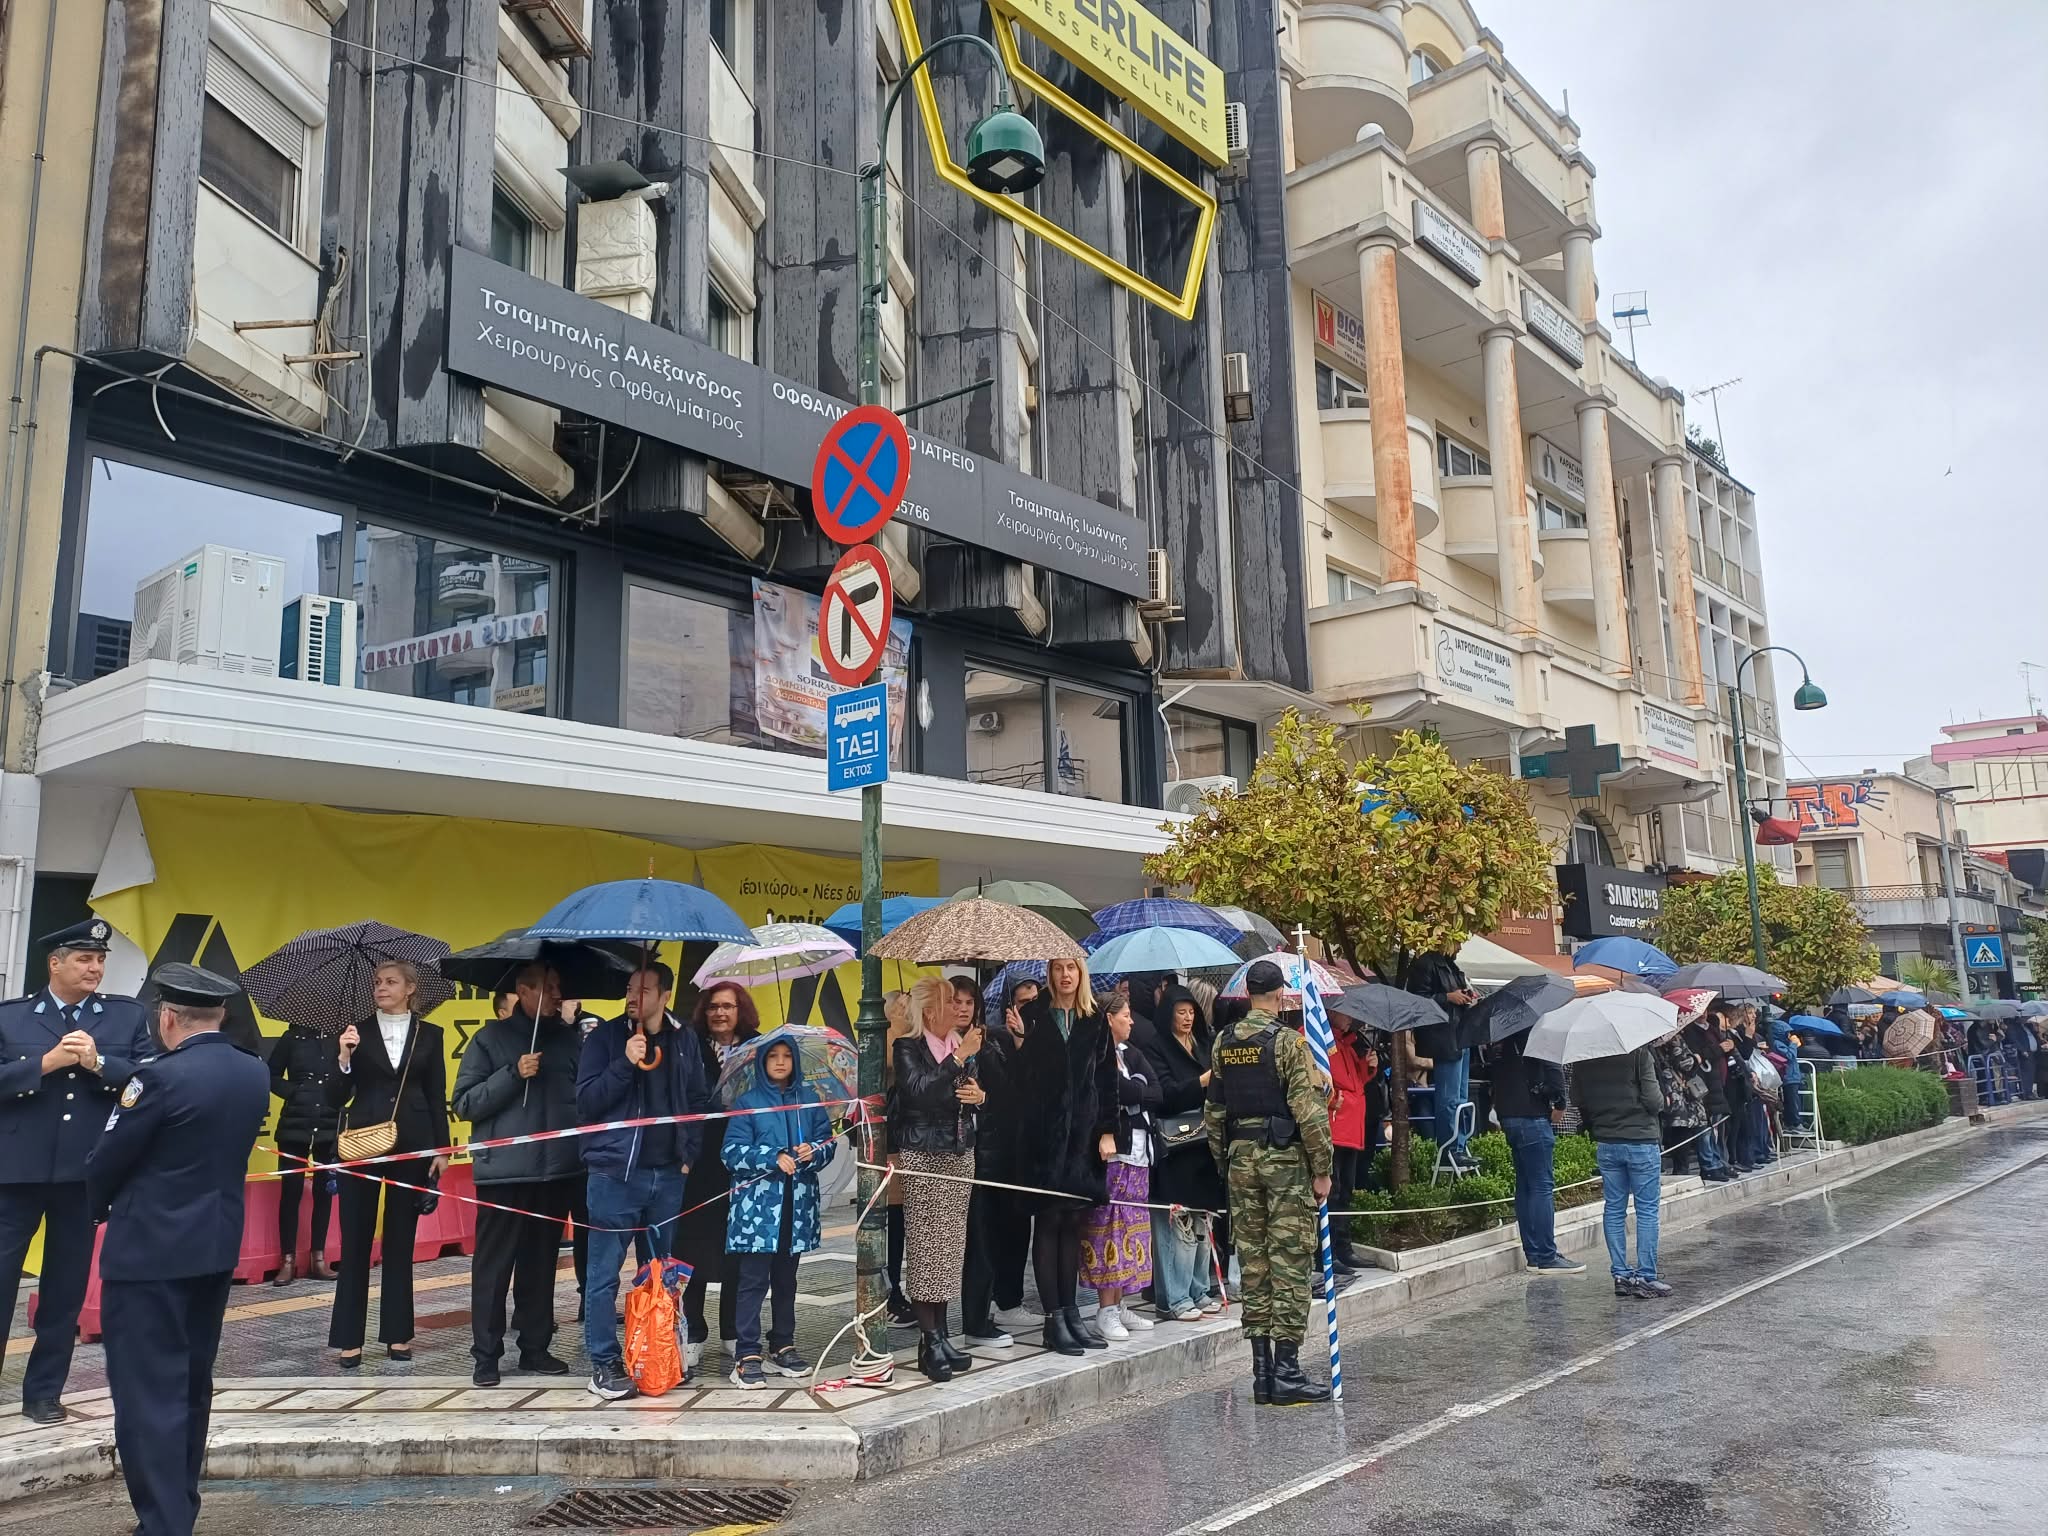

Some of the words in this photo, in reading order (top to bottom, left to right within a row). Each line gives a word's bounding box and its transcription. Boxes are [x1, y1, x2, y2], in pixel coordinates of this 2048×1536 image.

[1090, 34, 1208, 133] EXCELLENCE
[480, 287, 620, 362] Τσιαμπαλής
[624, 345, 742, 408] Αλέξανδρος
[477, 321, 603, 389] Χειρουργός
[609, 371, 744, 439] Οφθαλμίατρος
[921, 440, 975, 473] ΙΑΤΡΕΙΟ
[996, 511, 1063, 550] Χειρουργός
[1008, 489, 1080, 533] Τσιαμπαλής
[1083, 518, 1128, 550] Ιωάννης
[765, 674, 806, 693] ΔΟΜΗΣΗ
[797, 674, 837, 693] SORRAS
[836, 729, 879, 760] ΤΑΞΙ
[843, 763, 873, 779] ΕΚΤΟΣ
[813, 883, 843, 901] Νέες
[1607, 883, 1659, 910] SAMSUNG
[1609, 914, 1637, 928] Customer
[1221, 1046, 1263, 1057] MILITARY
[1224, 1055, 1260, 1065] POLICE
